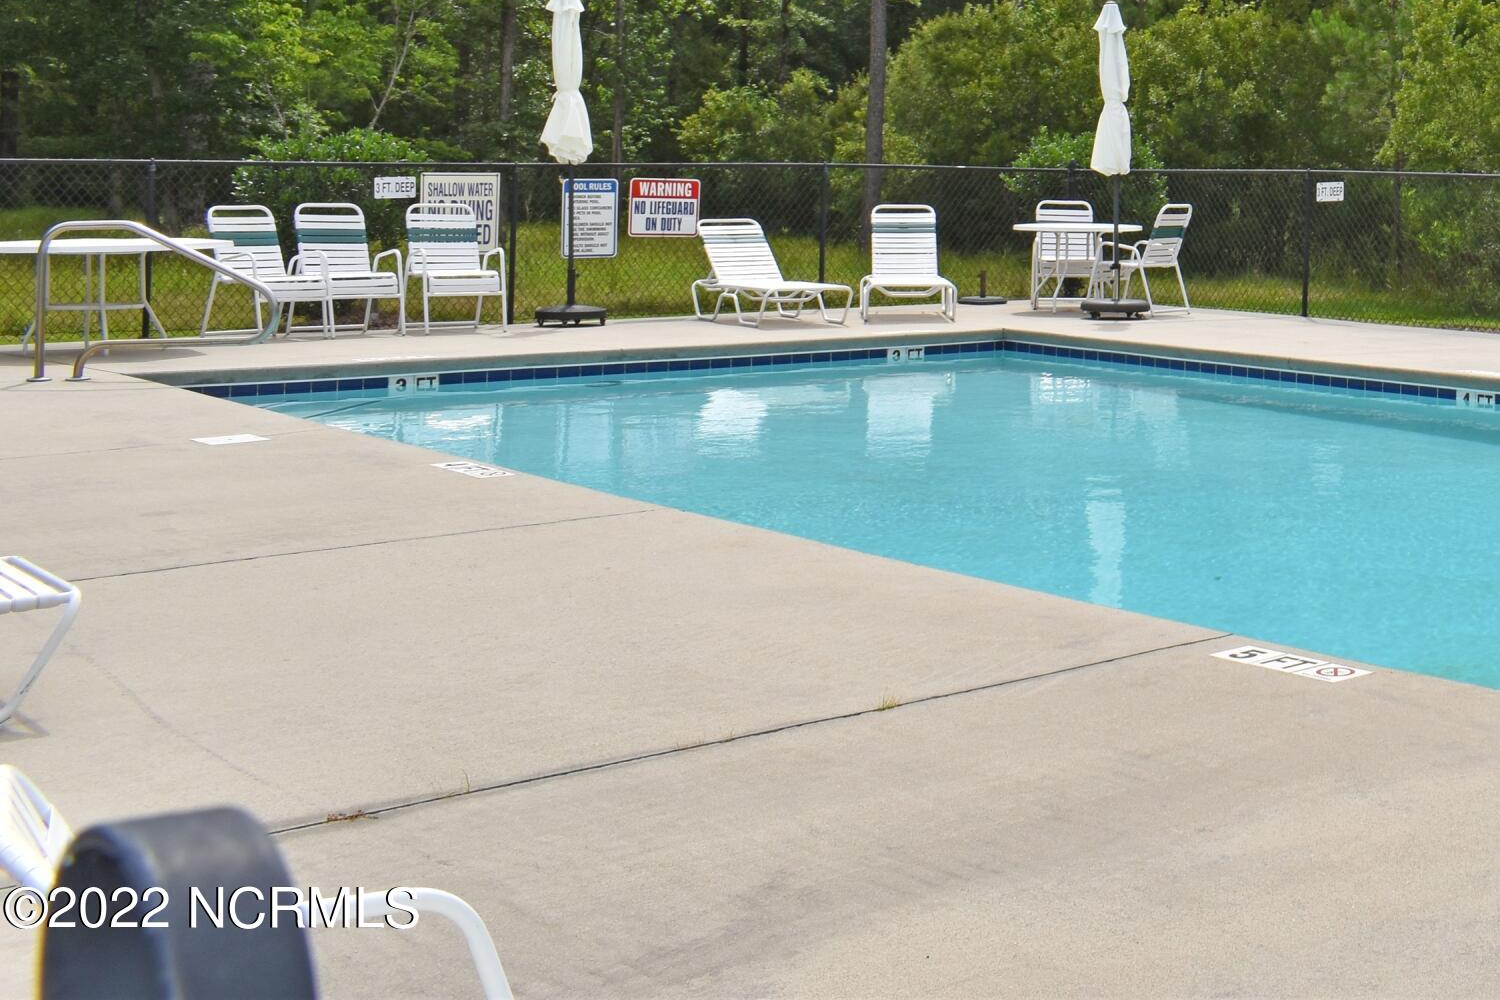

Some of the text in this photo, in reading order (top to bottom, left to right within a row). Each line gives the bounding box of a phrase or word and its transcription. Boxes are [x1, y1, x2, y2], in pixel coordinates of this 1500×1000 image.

[376, 182, 414, 193] 3 FT. DEEP
[428, 182, 493, 197] SHALLOW WATER
[573, 183, 588, 191] OOL
[640, 182, 692, 197] WARNING
[634, 201, 695, 215] NO LIFEGUARD
[645, 217, 682, 231] ON DUTY
[1229, 649, 1318, 670] 5 FT
